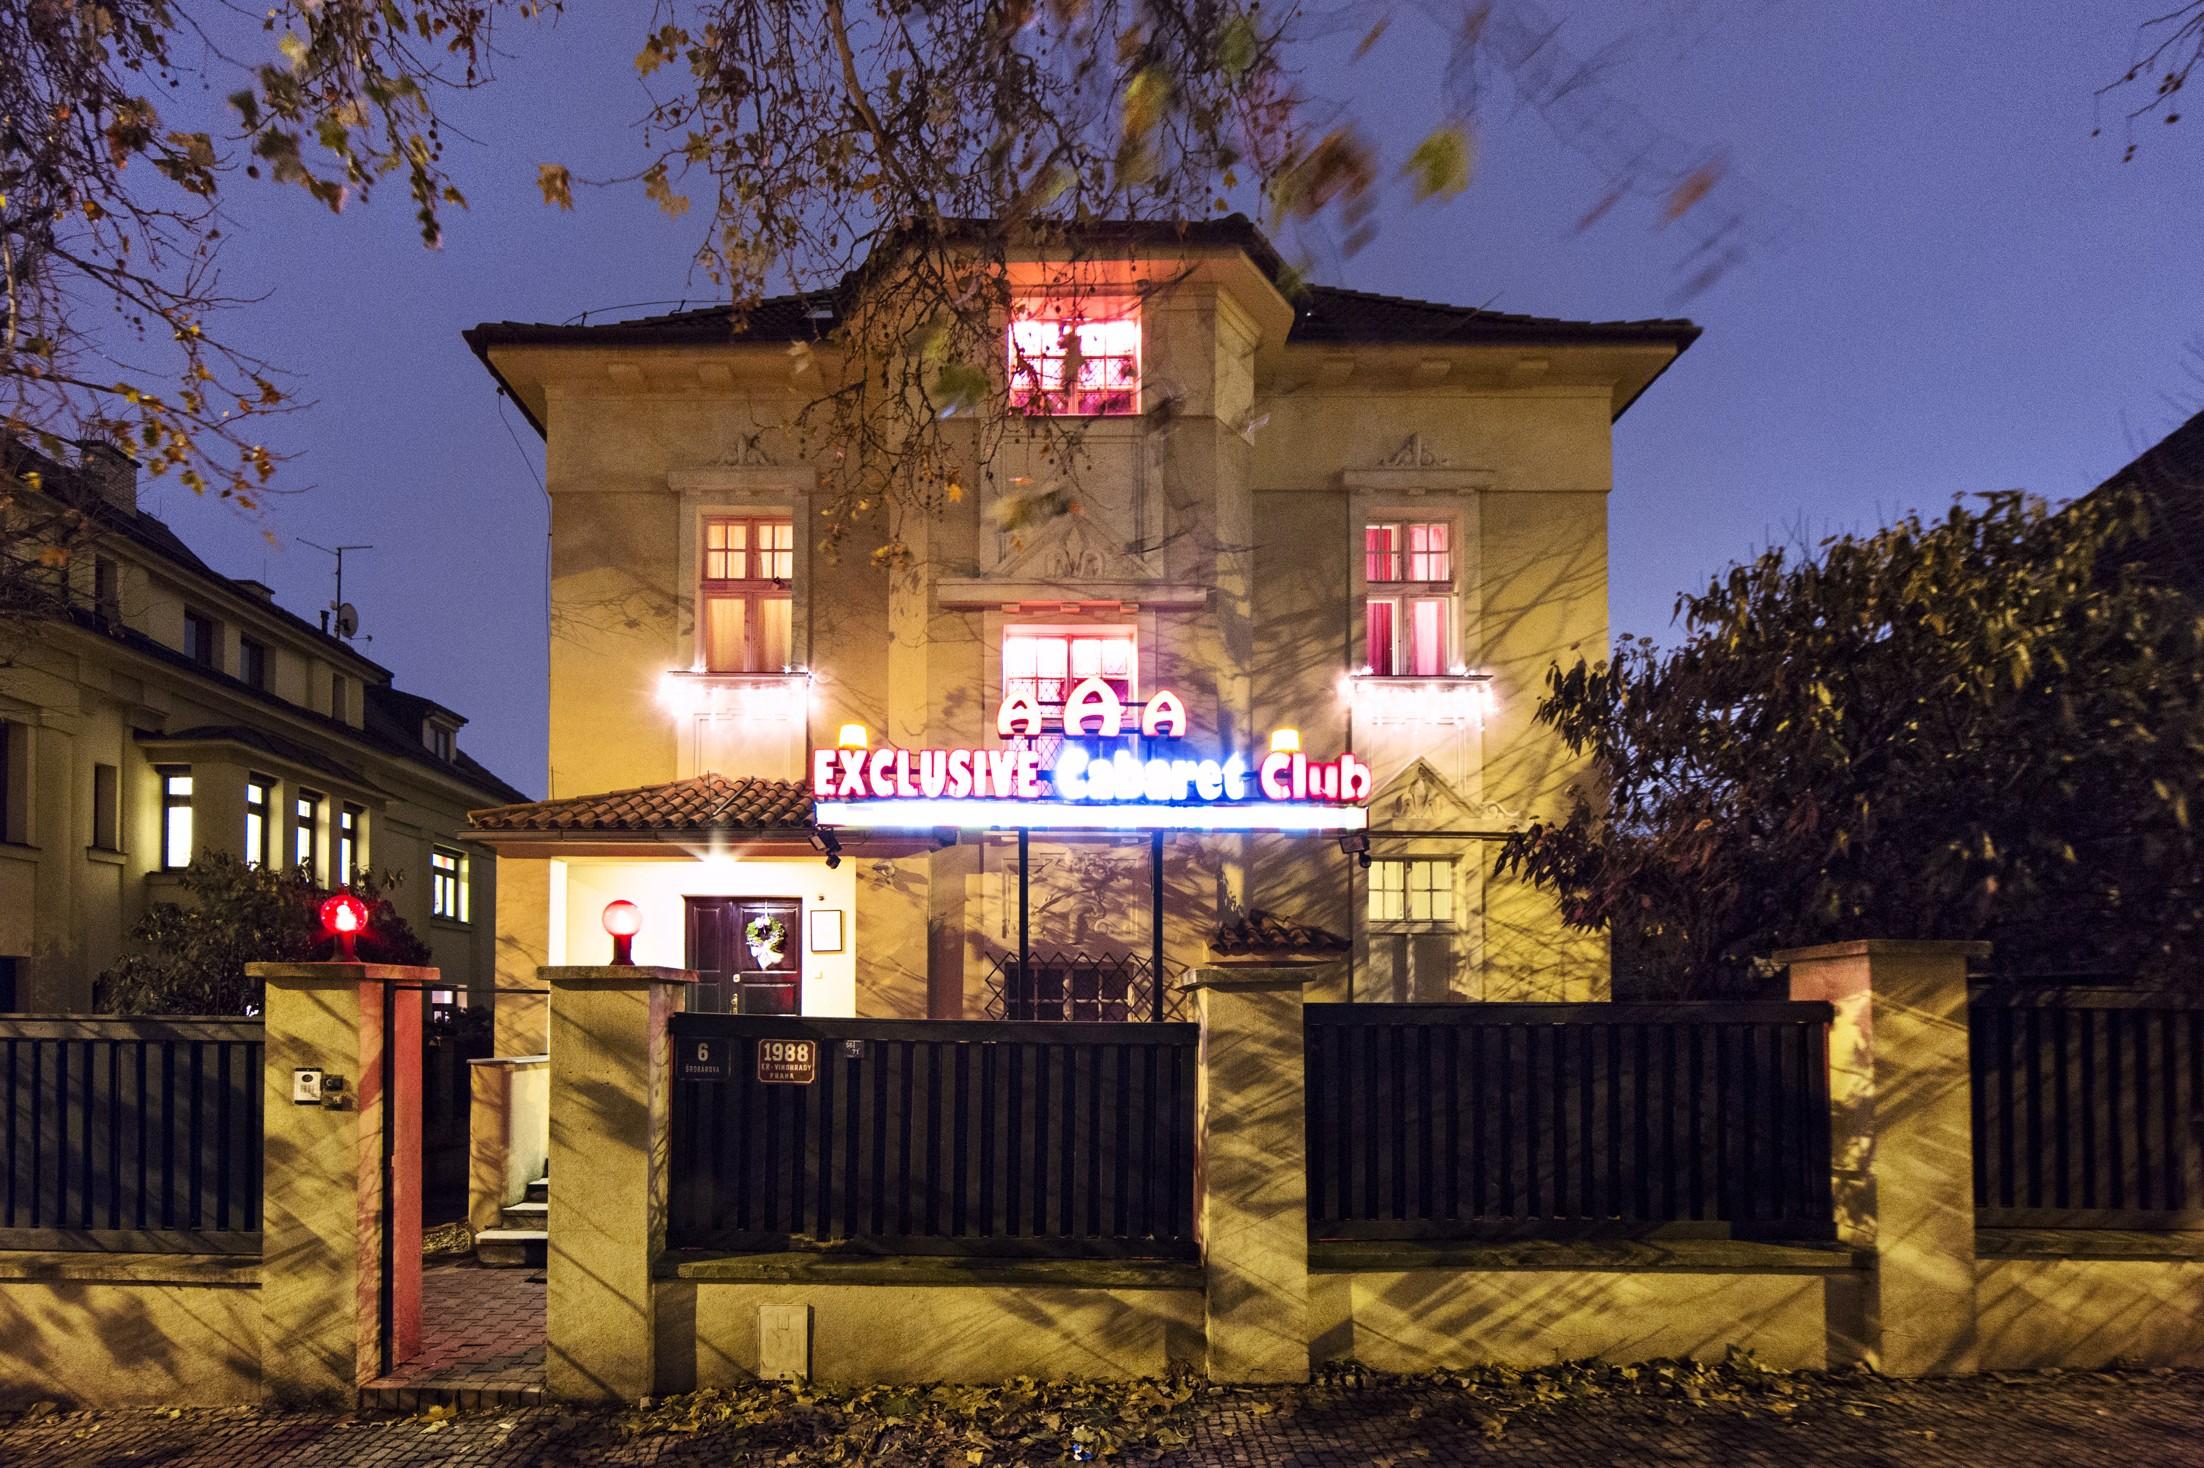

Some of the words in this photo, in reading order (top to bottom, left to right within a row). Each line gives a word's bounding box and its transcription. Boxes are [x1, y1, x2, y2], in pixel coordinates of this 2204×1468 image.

[814, 748, 1041, 798] EXCLUSIVE
[1056, 748, 1247, 801] Cabaret
[1260, 751, 1373, 801] Club
[697, 1042, 709, 1062] 6
[764, 1043, 809, 1062] 1988
[769, 1072, 795, 1080] PRAHA
